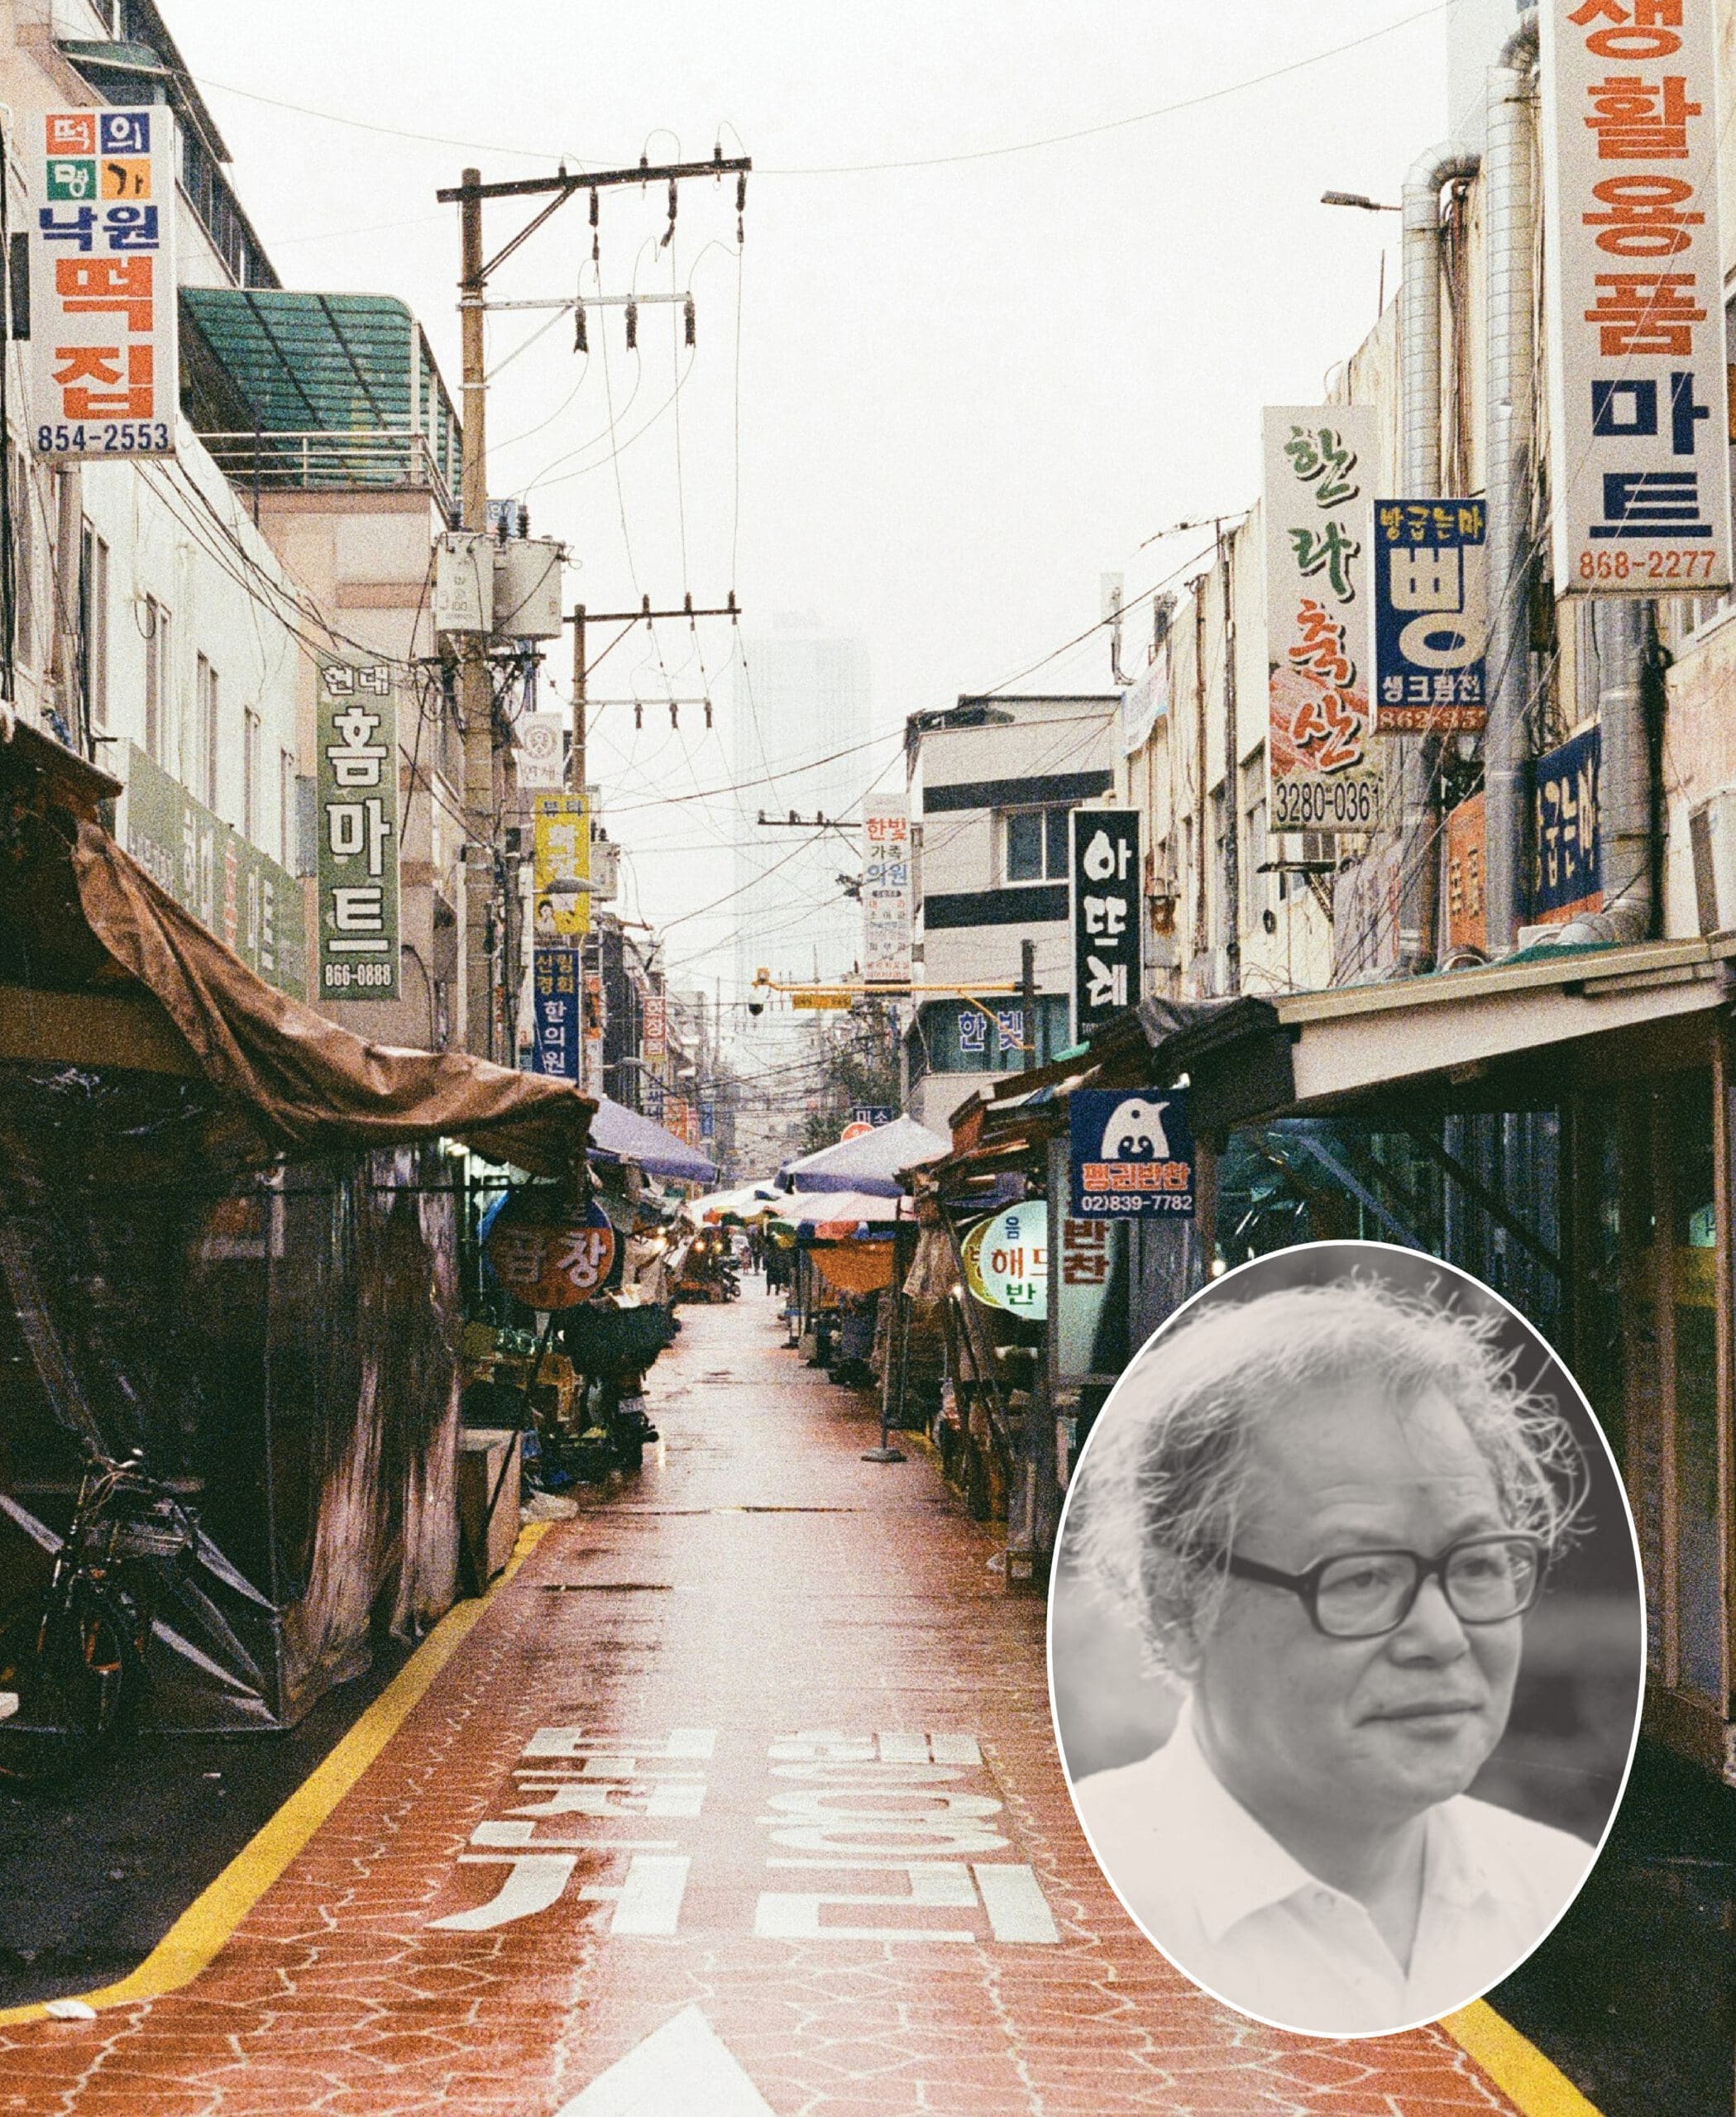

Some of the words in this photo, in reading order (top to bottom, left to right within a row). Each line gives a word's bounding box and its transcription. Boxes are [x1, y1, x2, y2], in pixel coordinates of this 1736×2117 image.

[55, 163, 145, 198] 명가
[1568, 0, 1707, 356] 생활용품
[39, 205, 160, 252] 낙원
[51, 256, 155, 420] 떡집
[37, 423, 168, 453] 854-2553
[1590, 372, 1713, 538] 마트
[1284, 424, 1360, 603] 한라
[1579, 551, 1716, 580] 868-2277
[323, 666, 390, 695] 현대
[1289, 598, 1365, 773] 축산
[326, 707, 392, 953] 홈마트
[872, 845, 901, 859] 가족
[867, 863, 907, 886] 의원
[325, 963, 392, 987] 866-0888
[543, 1000, 567, 1074] 한의원
[1082, 1162, 1191, 1192] 펭귄반찬
[1082, 1195, 1193, 1211] 02)839-7782
[469, 1784, 1015, 1855] 전용
[423, 1853, 1063, 1945] 거리
